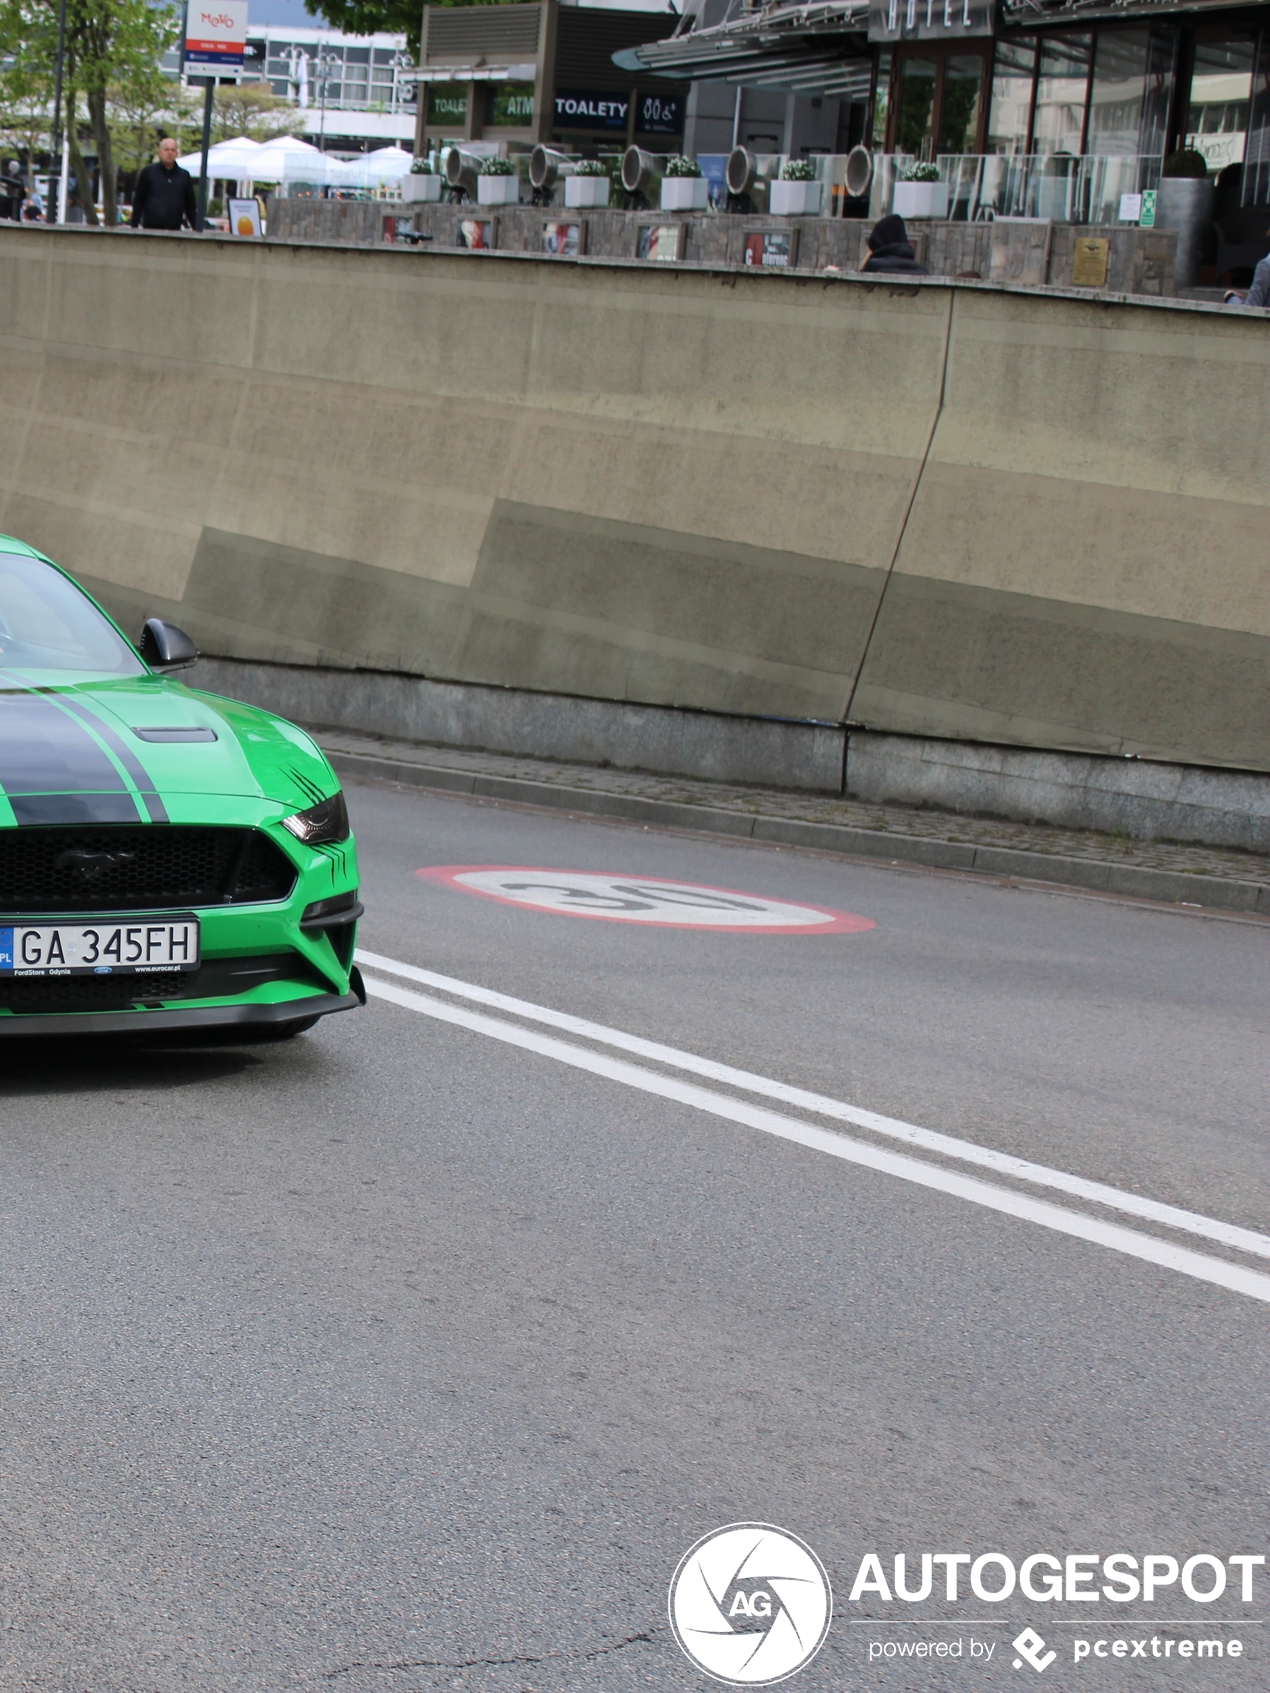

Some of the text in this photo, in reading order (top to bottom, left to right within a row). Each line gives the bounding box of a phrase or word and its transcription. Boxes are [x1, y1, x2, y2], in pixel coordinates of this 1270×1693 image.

[888, 0, 971, 30] HOTEL
[434, 98, 468, 114] TOALE
[506, 96, 534, 115] ATM
[555, 98, 628, 118] TOALETY
[22, 926, 188, 965] GA 345FH
[49, 968, 71, 976] Gdynia
[135, 964, 181, 972] www.eurocar.pl
